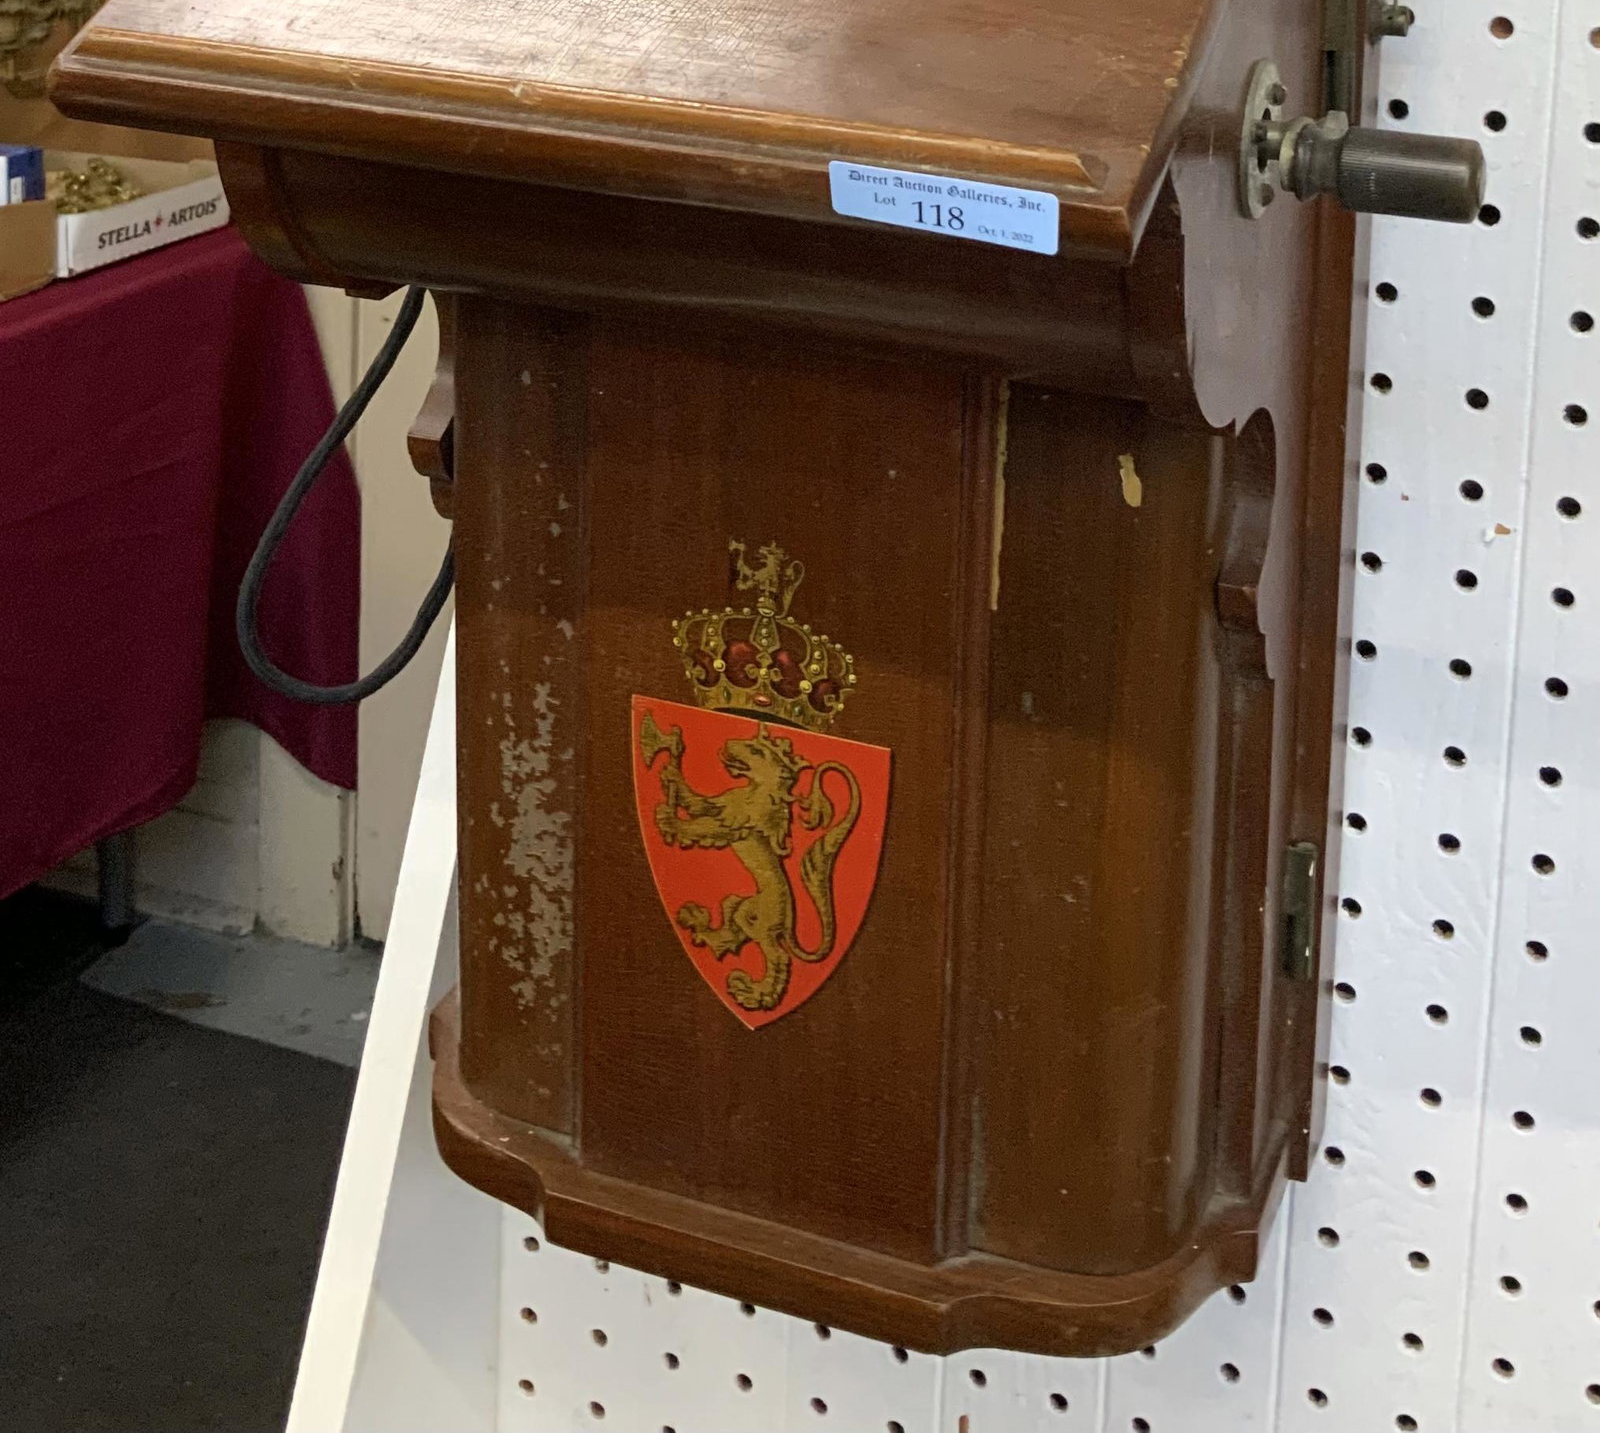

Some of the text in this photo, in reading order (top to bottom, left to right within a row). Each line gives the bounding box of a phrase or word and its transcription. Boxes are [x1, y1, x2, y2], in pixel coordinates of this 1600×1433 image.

[848, 169, 1046, 213] Direct Auction Galleries, Inc.
[874, 192, 965, 231] Lot 118
[98, 199, 217, 249] STELLA ARTOIS
